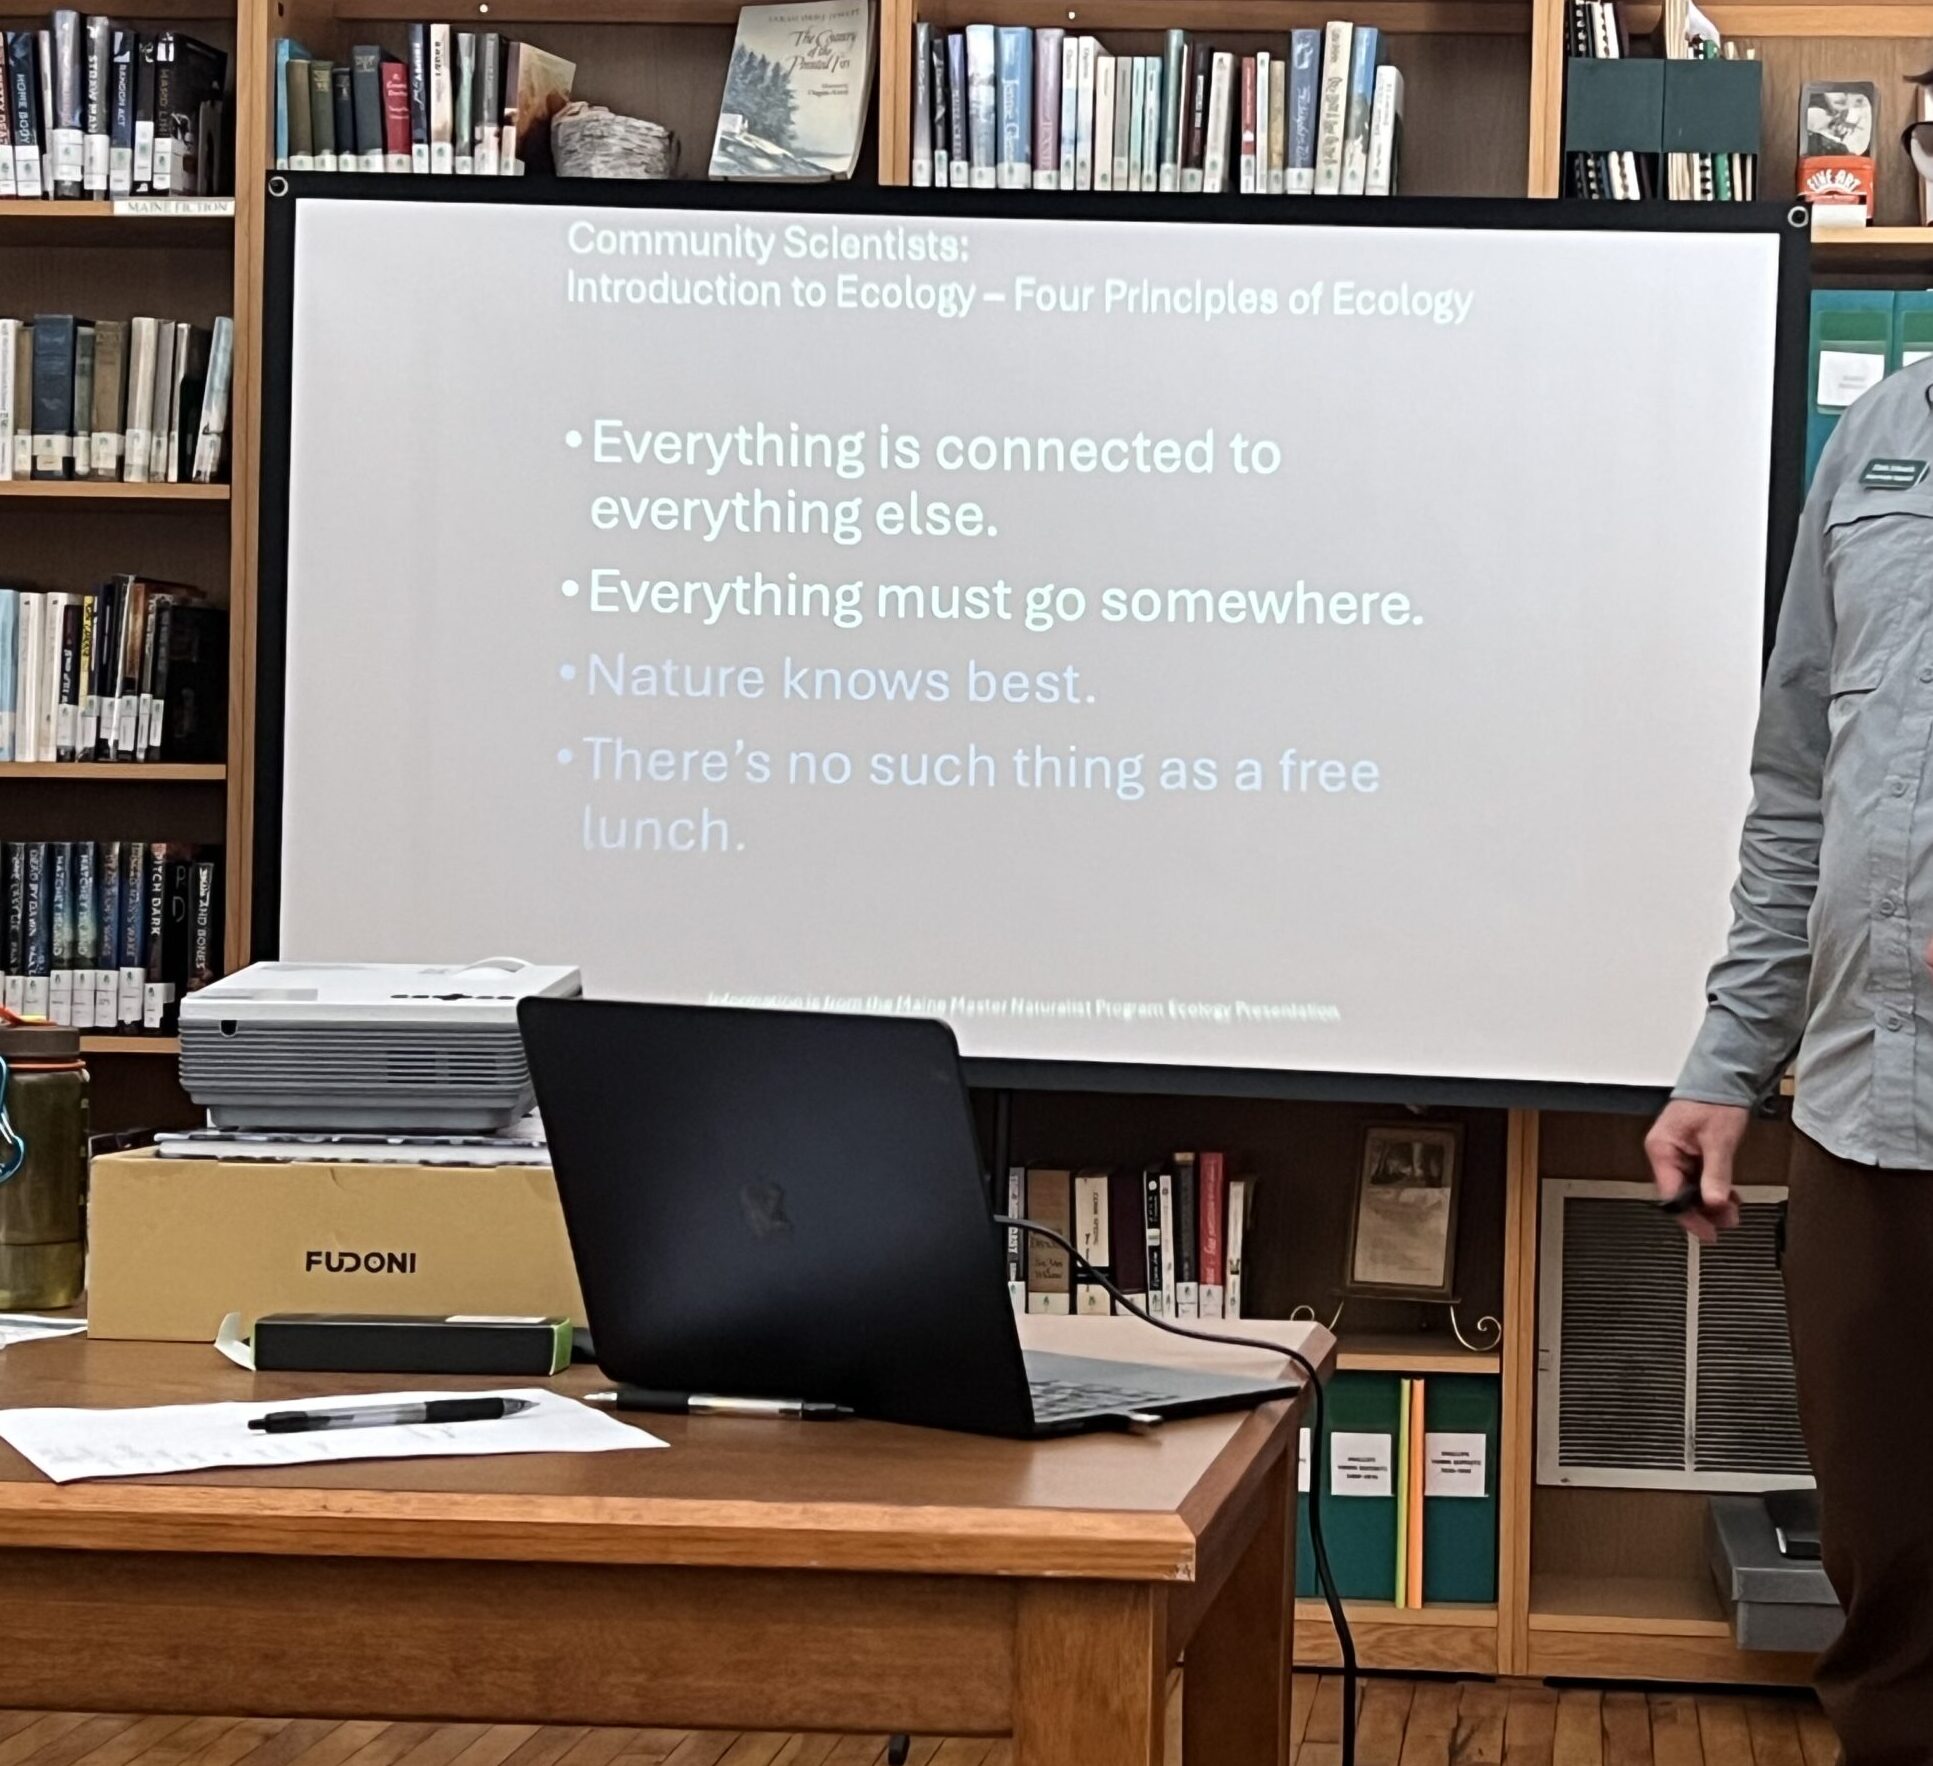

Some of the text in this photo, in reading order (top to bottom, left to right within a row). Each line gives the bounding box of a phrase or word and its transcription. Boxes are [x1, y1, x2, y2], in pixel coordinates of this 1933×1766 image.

[16, 73, 30, 144] HOME BODY
[88, 55, 99, 133] STRAW MAN
[117, 64, 128, 127] RANDOM ACT
[128, 201, 228, 213] MAINE FICTION
[568, 221, 969, 266] Community Scientists:
[568, 269, 782, 308] Introduction
[792, 276, 827, 308] to
[837, 273, 976, 317] Ecology
[1015, 276, 1095, 312] Four
[1105, 278, 1279, 322] Principles
[1288, 281, 1324, 315] of
[1333, 281, 1475, 324] Ecology
[594, 419, 1281, 479] Everything is connected to
[591, 488, 998, 545] everything else.
[589, 568, 1424, 632] Everything must go somewhere.
[588, 652, 1096, 704] Nature knows best.
[789, 749, 851, 785] no
[869, 743, 996, 787] such
[1013, 745, 1145, 800] thing
[1159, 756, 1218, 792] as
[1235, 756, 1263, 792] a
[1279, 747, 1381, 793] free
[583, 804, 746, 852] lunch.
[54, 855, 65, 909] HATCHET
[79, 854, 89, 908] HATCHET
[151, 898, 161, 935] DARK
[896, 995, 947, 1015] Maine
[951, 996, 1007, 1016] Master
[1011, 998, 1092, 1019] Naturalist
[1096, 998, 1165, 1021] Program
[1168, 998, 1232, 1022] Ecology
[1235, 999, 1341, 1021] Presentation
[306, 1251, 416, 1273] FUDONI
